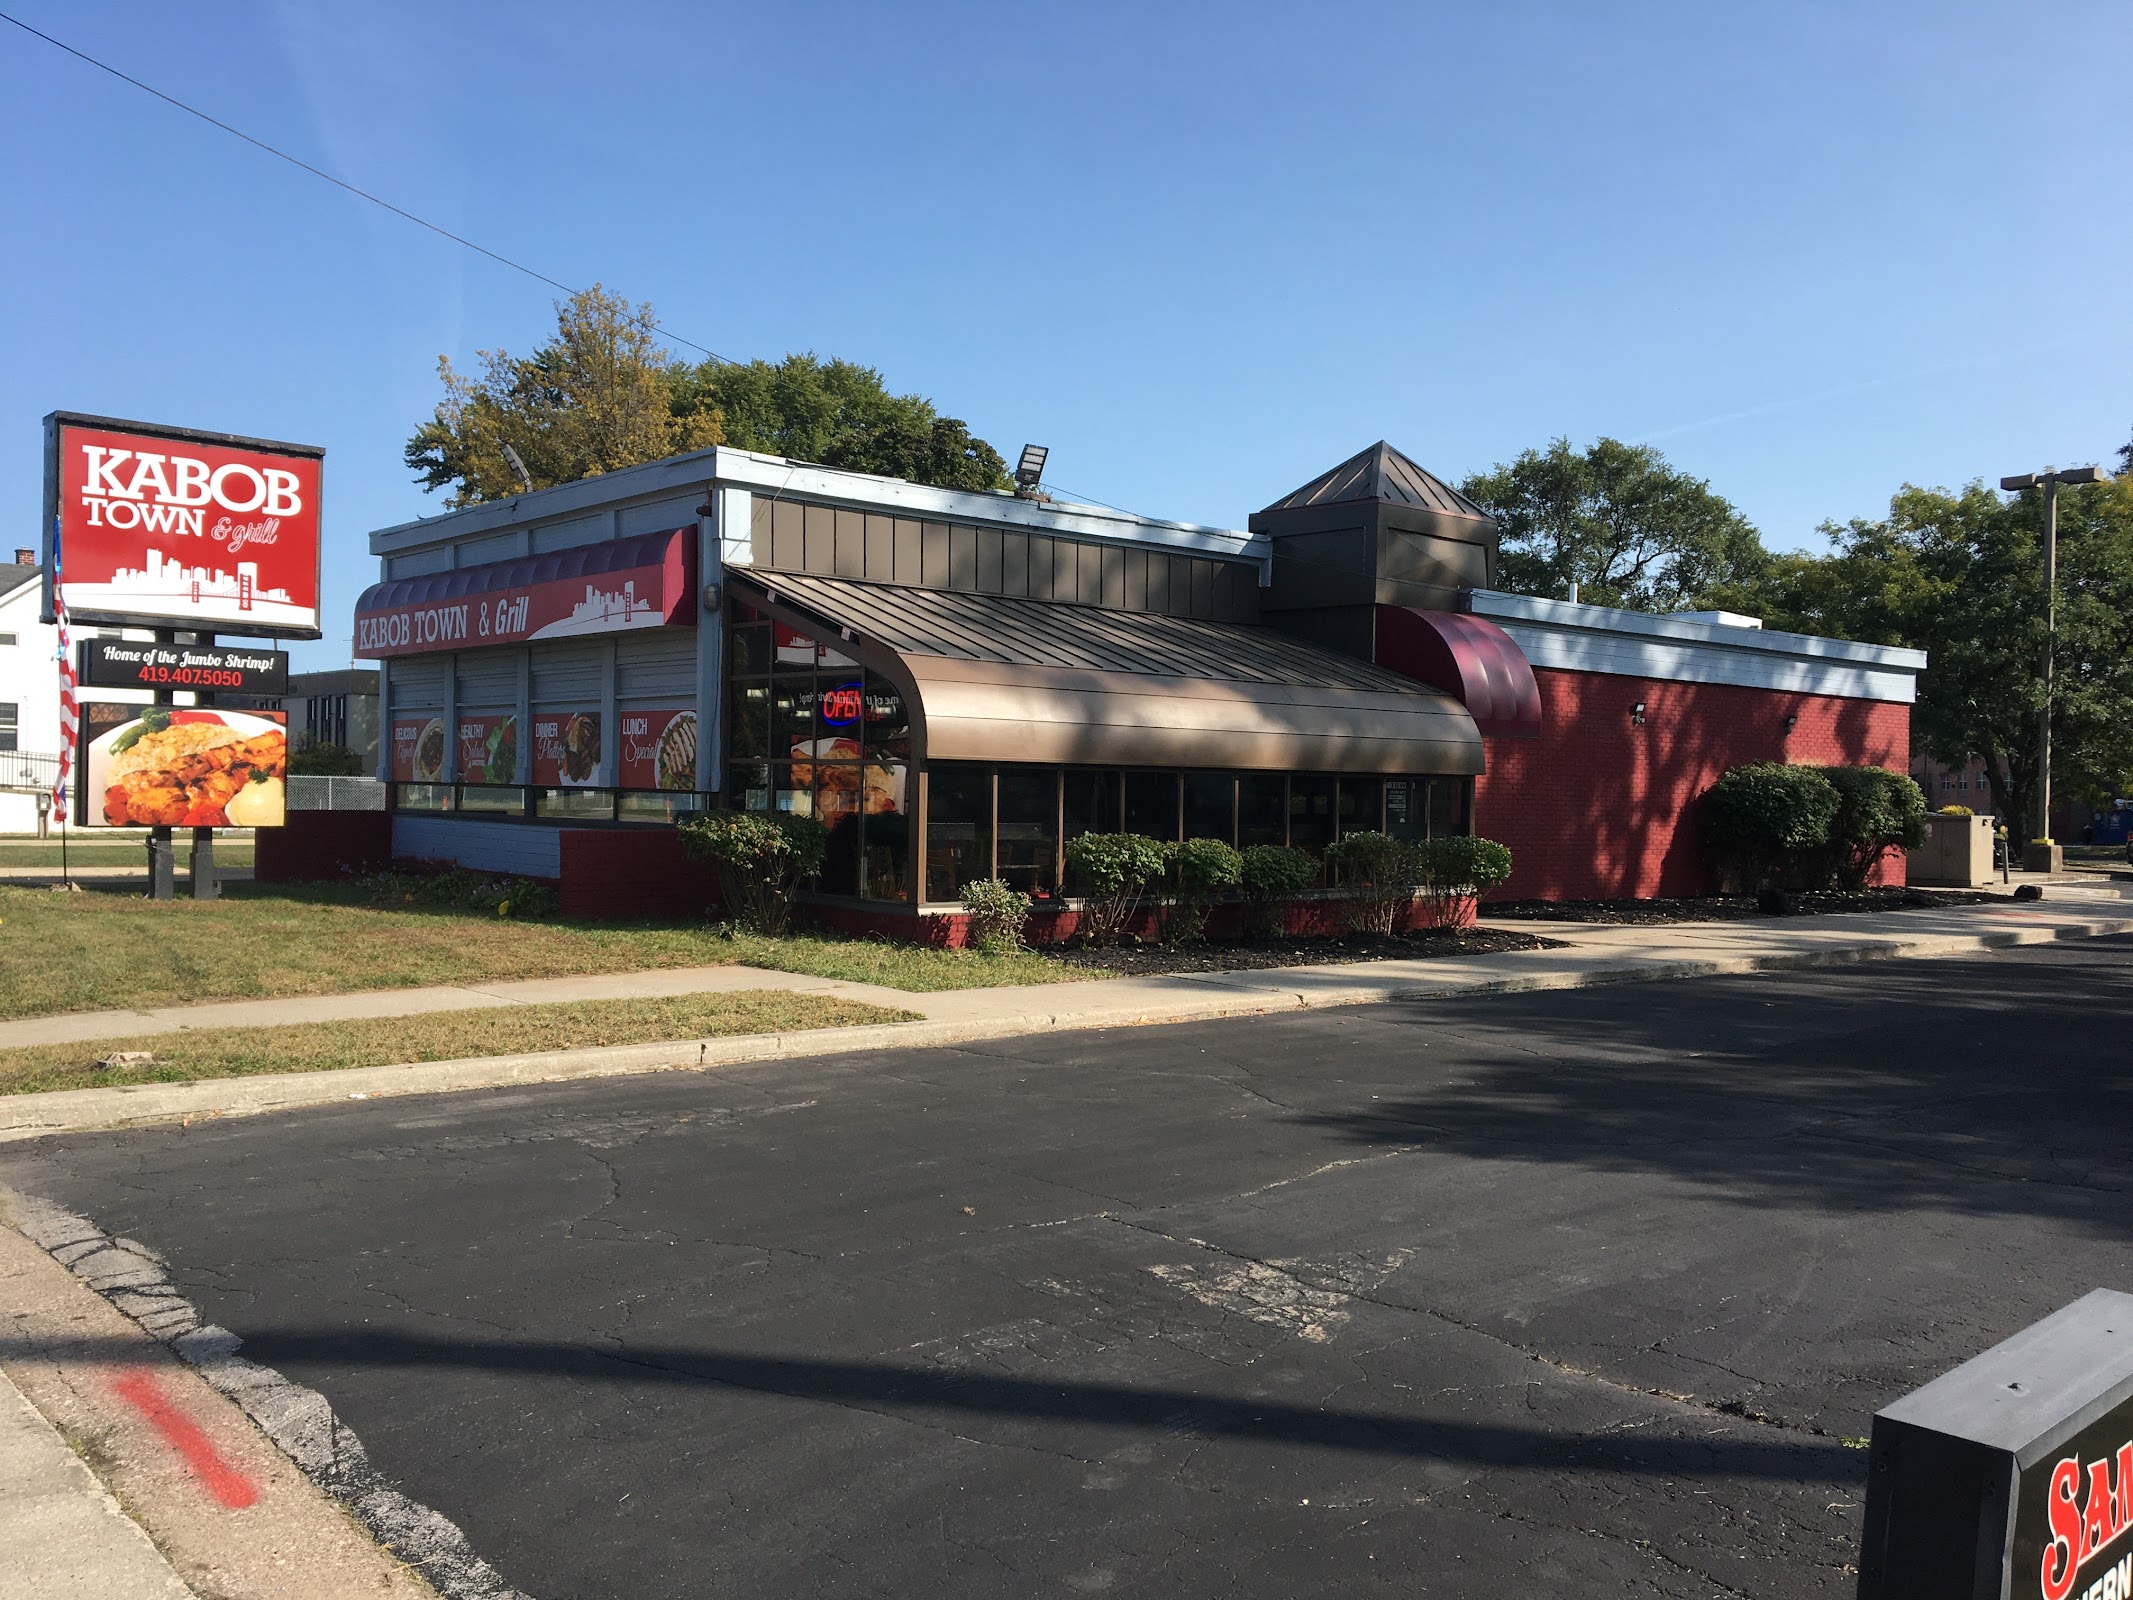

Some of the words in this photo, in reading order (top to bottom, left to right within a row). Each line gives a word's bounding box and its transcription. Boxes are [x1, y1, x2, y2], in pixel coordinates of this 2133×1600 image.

[81, 444, 302, 517] KABOB
[81, 496, 206, 537] TOWN
[211, 516, 232, 541] &
[227, 517, 280, 553] grill
[359, 613, 410, 650] KABOB
[415, 604, 469, 644] TOWN
[478, 601, 490, 637] &
[495, 596, 529, 635] Grill
[103, 645, 140, 662] Home
[143, 649, 156, 666] of
[158, 650, 176, 664] the
[179, 651, 222, 668] Jumbo
[224, 653, 275, 673] Shrimp!
[823, 690, 862, 719] OPEN
[461, 724, 485, 740] HEALTHY
[535, 722, 558, 738] DINNER
[622, 718, 648, 735] LUNCH
